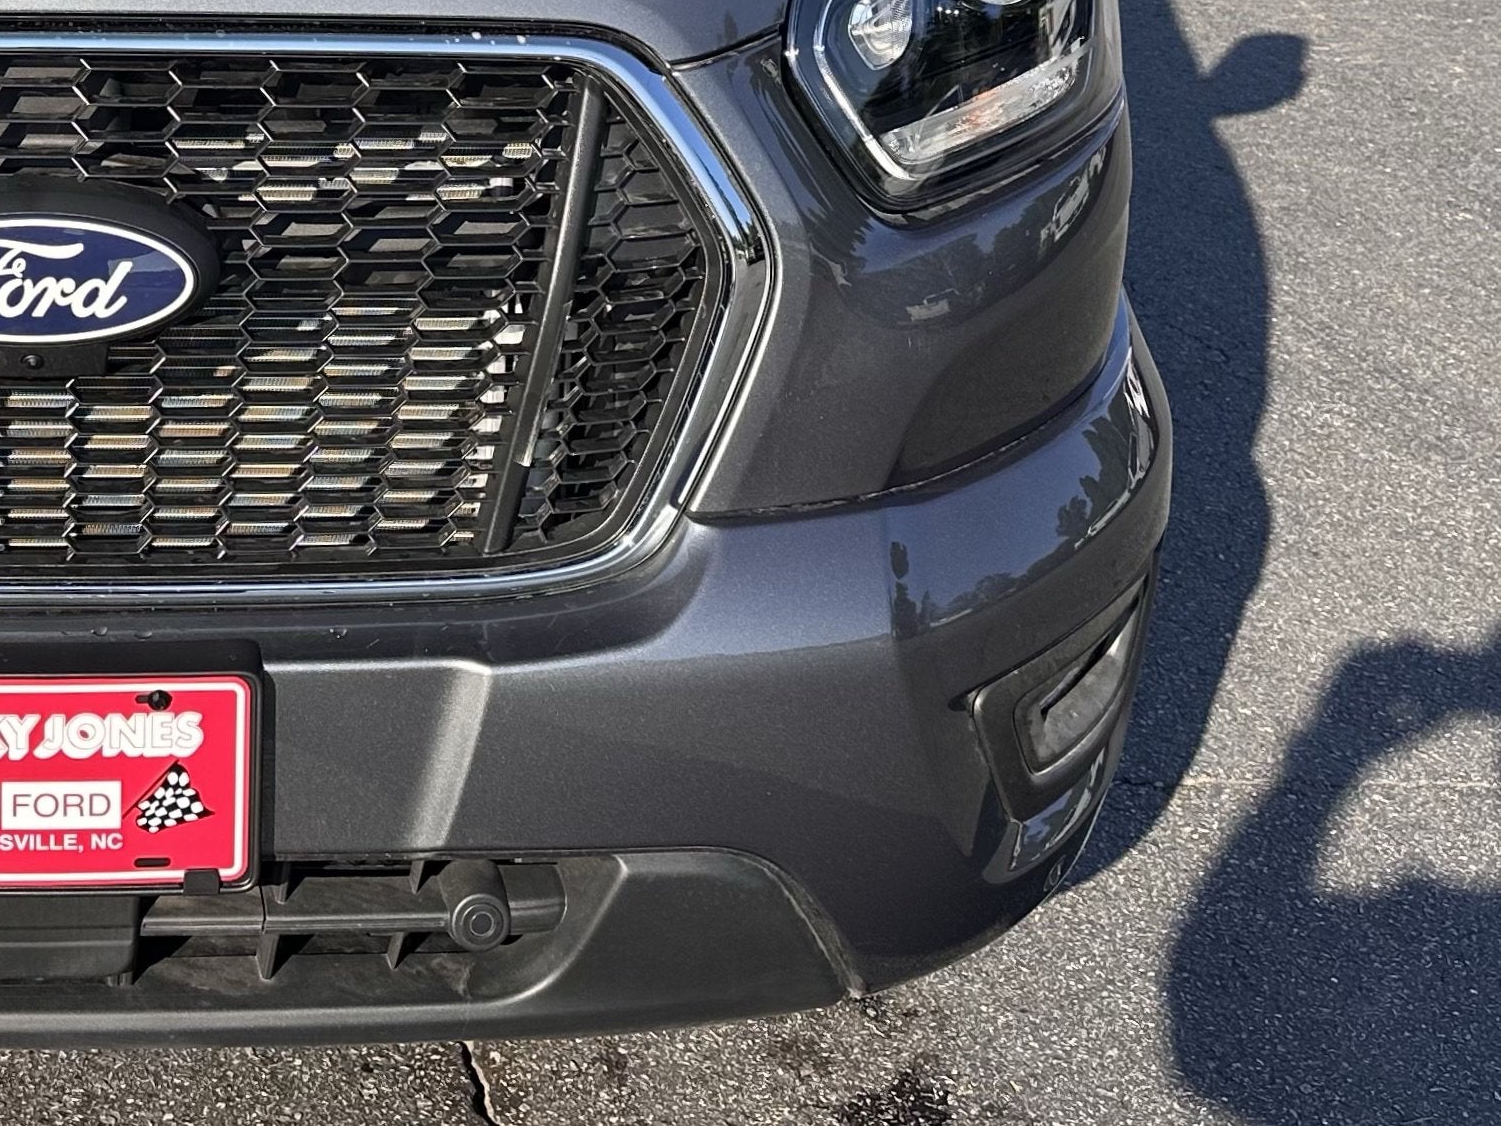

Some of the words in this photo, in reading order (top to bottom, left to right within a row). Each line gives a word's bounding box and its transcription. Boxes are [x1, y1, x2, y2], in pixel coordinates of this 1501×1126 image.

[33, 711, 204, 759] JONES
[12, 793, 111, 818] FORD
[91, 833, 124, 851] NC
